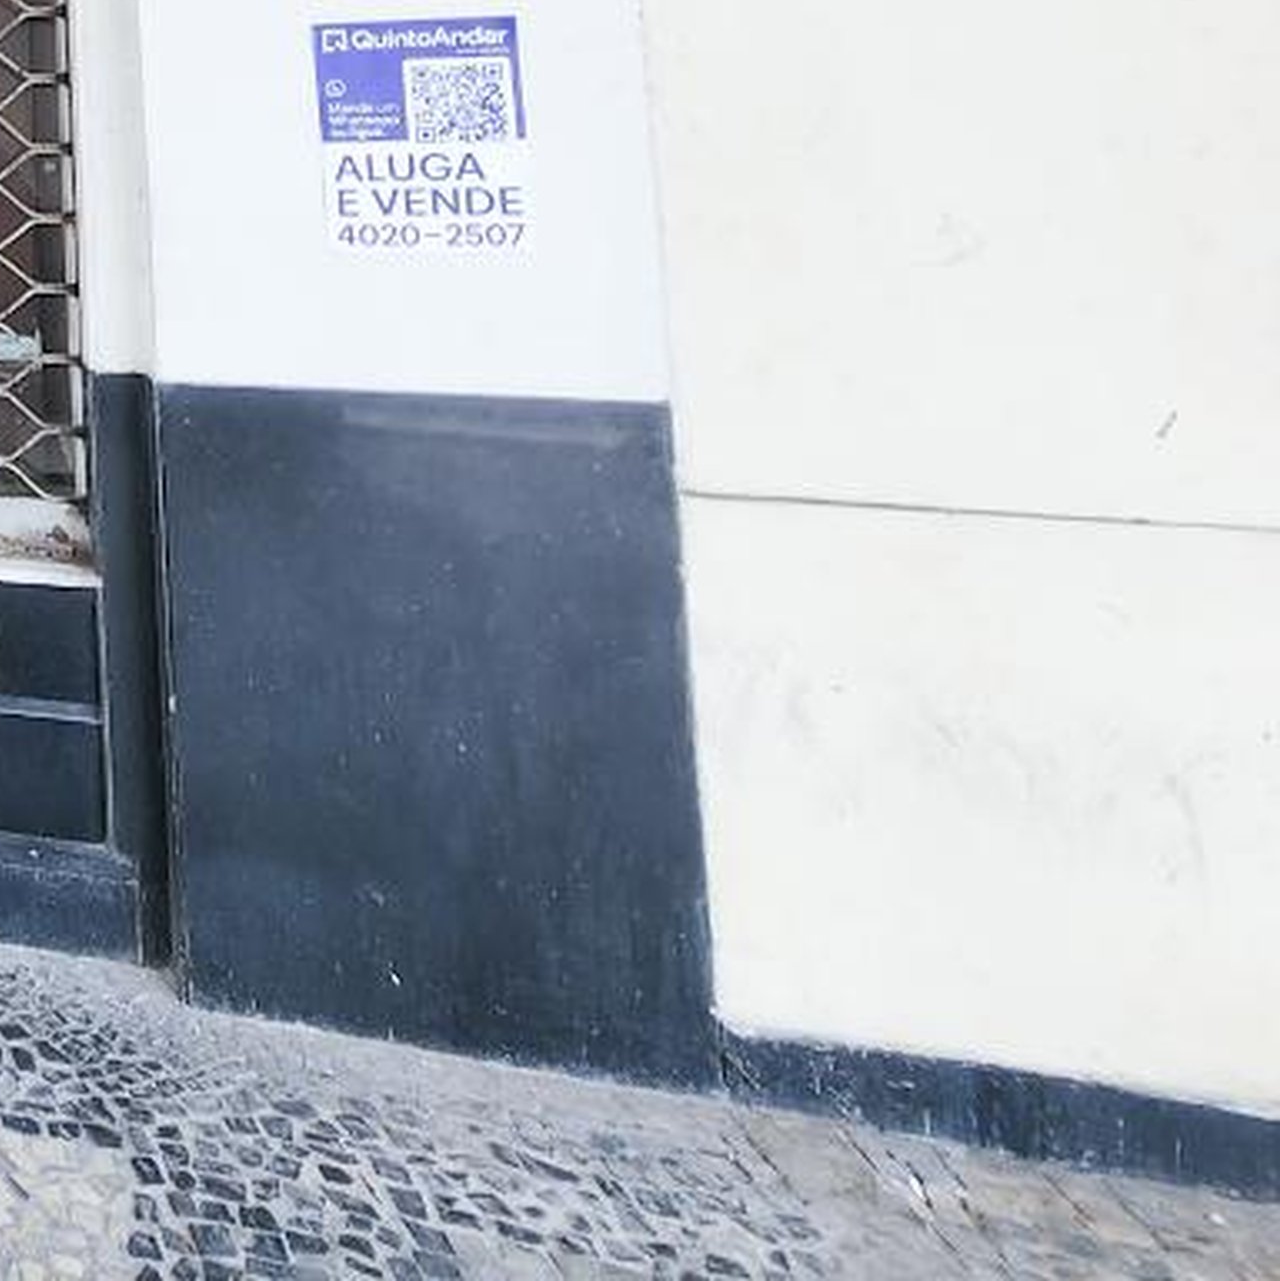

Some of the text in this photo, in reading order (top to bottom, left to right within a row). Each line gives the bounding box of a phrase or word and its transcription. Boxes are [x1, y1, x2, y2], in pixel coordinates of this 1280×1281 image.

[351, 27, 508, 50] QuintoAndar
[335, 152, 486, 182] ALUGA
[337, 185, 524, 217] E VENDE
[337, 222, 526, 247] 4020-2507
